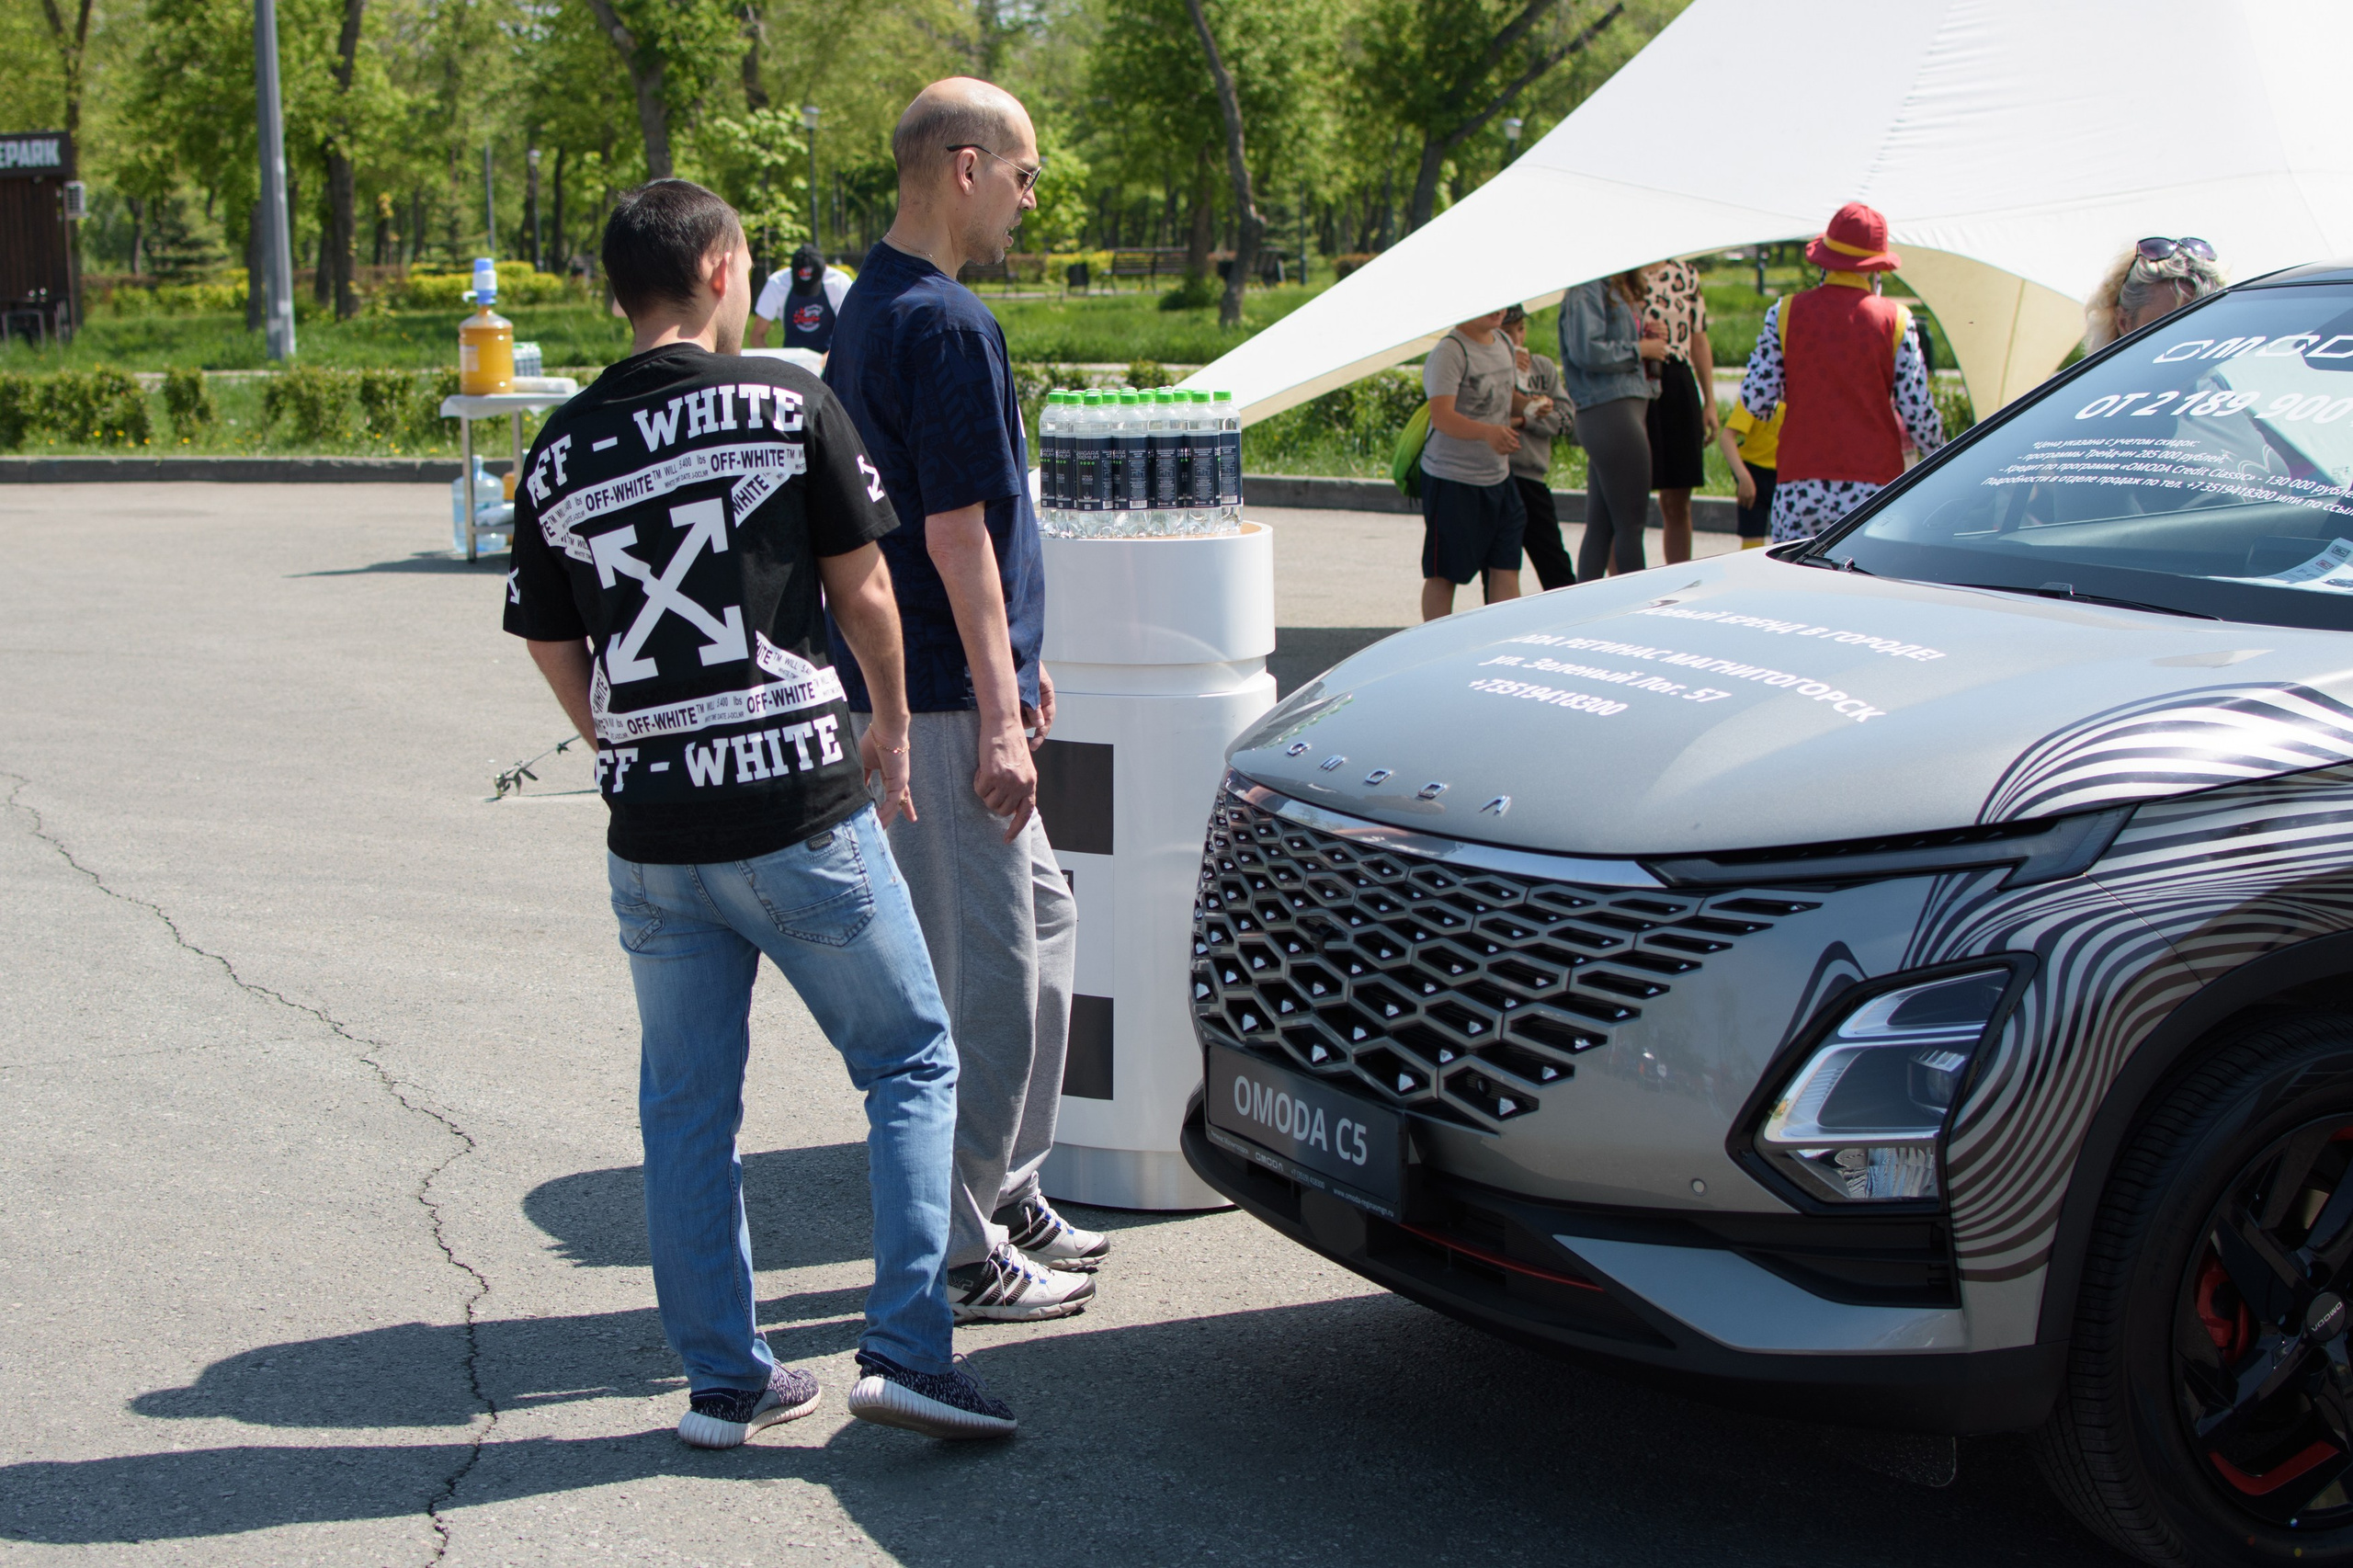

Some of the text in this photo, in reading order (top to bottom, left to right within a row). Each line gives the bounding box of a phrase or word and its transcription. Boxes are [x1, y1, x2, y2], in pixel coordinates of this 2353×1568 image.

[632, 383, 804, 452] WHITE
[2075, 392, 2151, 419] ОТ
[2131, 391, 2180, 416] 2
[585, 473, 654, 512] OFF-WHITE
[710, 449, 785, 472] OFF-WHITE
[2171, 465, 2210, 476] Credit
[2265, 475, 2292, 486] 130
[2288, 479, 2317, 491] 000
[2308, 484, 2353, 499] рубле
[1715, 615, 1808, 634] БРЕНД
[1818, 631, 1946, 662] ГОРОДЕ!
[627, 707, 698, 735] OFF-WHITE
[746, 682, 815, 713] OFF-WHITE
[1521, 658, 1644, 684] Зеленый
[1681, 687, 1733, 703] 57
[1658, 650, 1887, 723] МАГНИТОГОРСК
[595, 747, 639, 794] FF
[685, 713, 844, 788] WHITE
[1287, 741, 1512, 816] OMODA
[1233, 1075, 1367, 1166] OMODA C5
